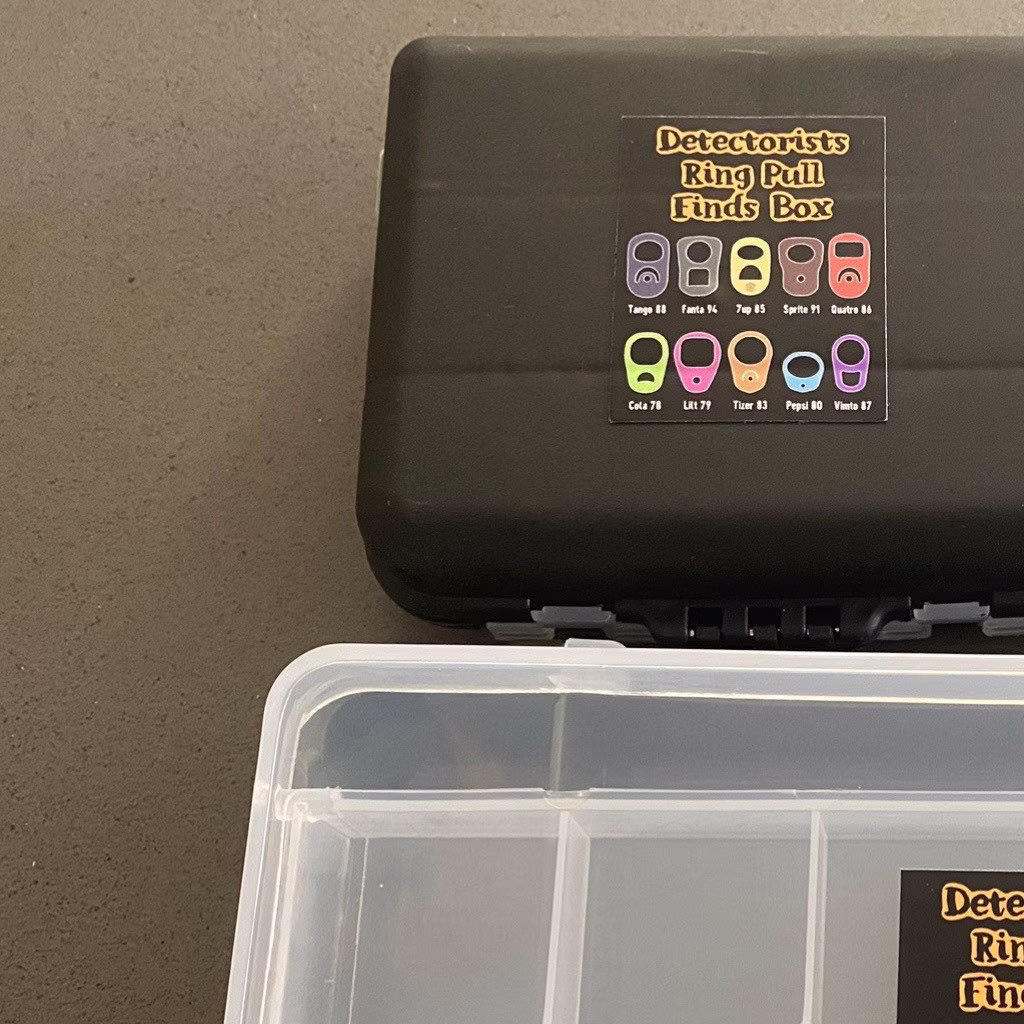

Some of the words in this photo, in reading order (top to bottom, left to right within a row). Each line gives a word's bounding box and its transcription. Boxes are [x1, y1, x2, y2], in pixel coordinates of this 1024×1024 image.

[657, 126, 849, 155] Detectorists
[682, 160, 755, 189] Ring
[761, 160, 824, 188] Pull
[671, 191, 759, 221] Finds
[770, 192, 834, 221] Box
[628, 304, 653, 315] Tango
[655, 304, 667, 314] 88
[682, 304, 704, 314] Fanta
[706, 304, 718, 314] 94
[736, 304, 752, 315] 7up
[754, 304, 765, 314] 85
[783, 304, 808, 315] Sprite
[811, 304, 820, 314] 91
[831, 304, 859, 315] Quatro
[861, 304, 872, 314] 86
[628, 401, 648, 410] Cola
[651, 401, 661, 410] 78
[683, 401, 698, 410] Lilt
[700, 401, 711, 410] 79
[733, 401, 754, 410] Tizer
[757, 401, 768, 410] 83
[786, 401, 809, 411] Pepsi
[811, 401, 822, 410] 80
[834, 401, 858, 410] Vimto
[861, 401, 872, 410] 87
